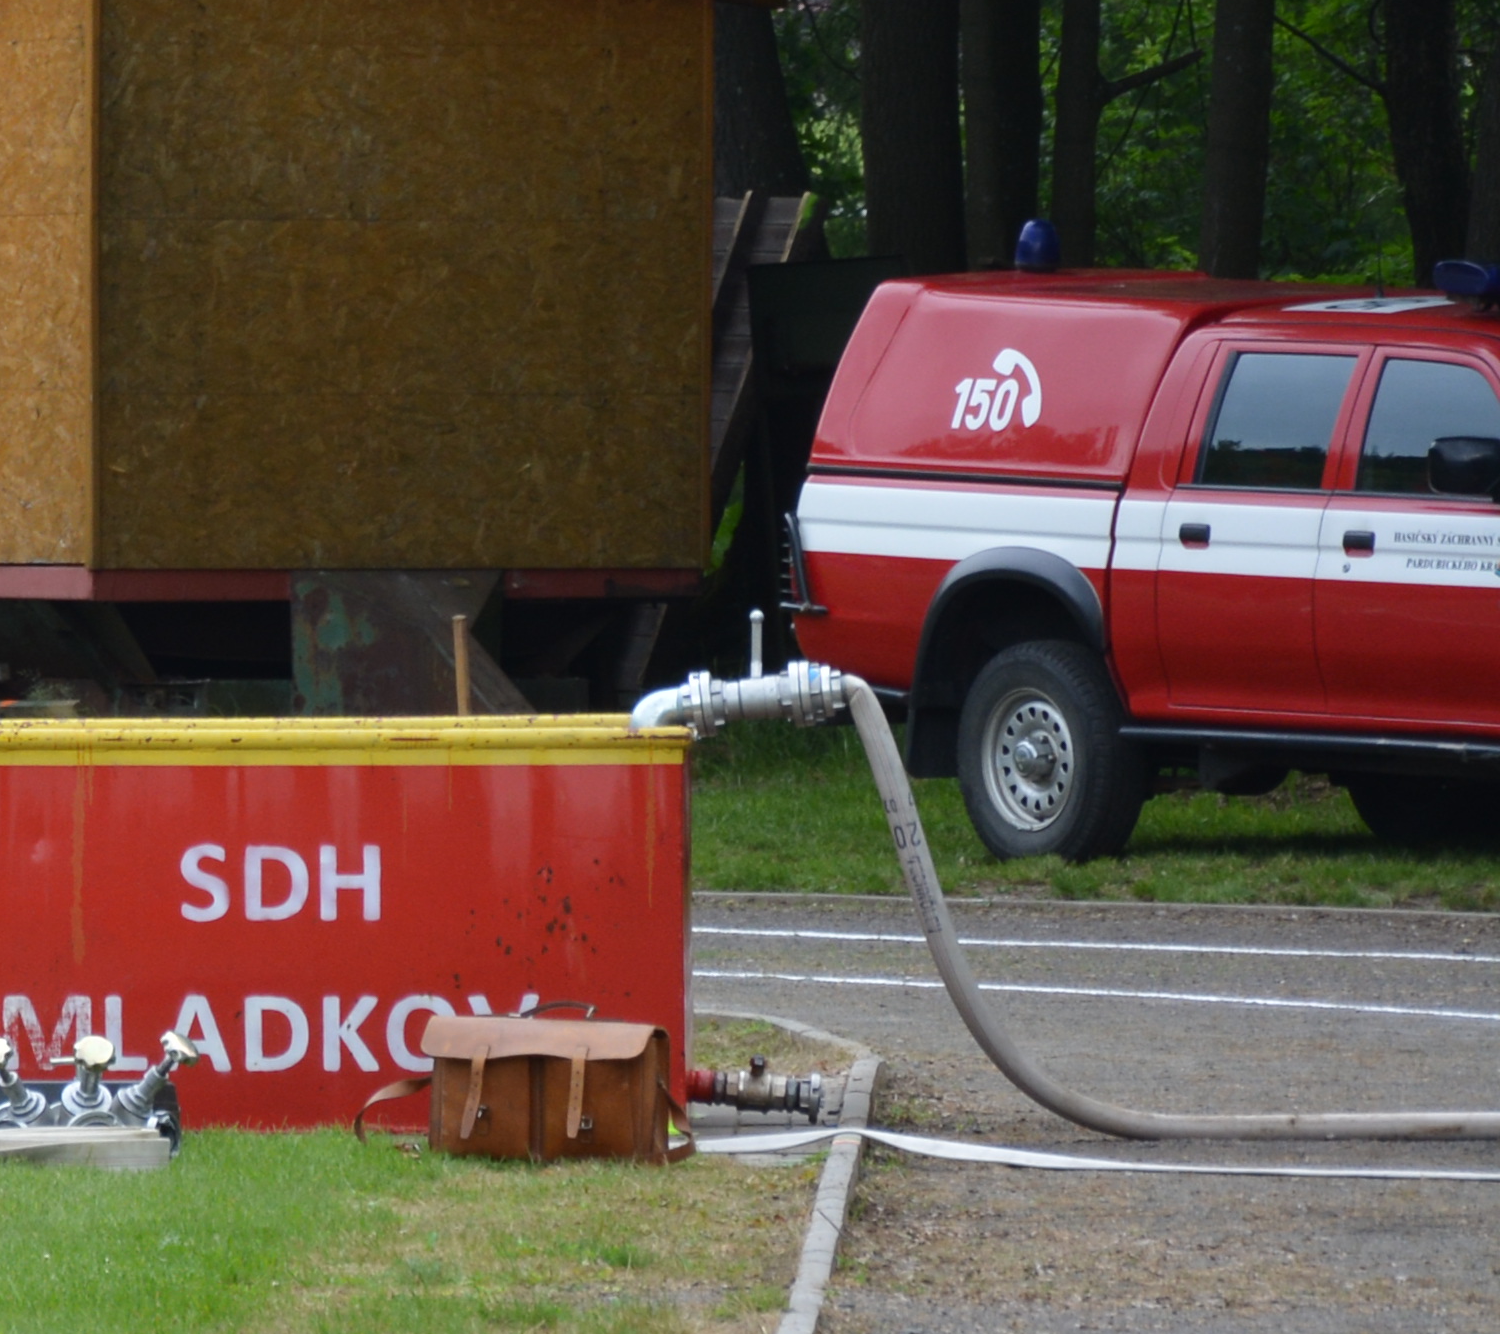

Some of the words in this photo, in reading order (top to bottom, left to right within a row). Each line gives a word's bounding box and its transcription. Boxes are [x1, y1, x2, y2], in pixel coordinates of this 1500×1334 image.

[951, 377, 1020, 432] 150
[180, 843, 382, 923] SDH
[1, 993, 540, 1073] MLADKO
